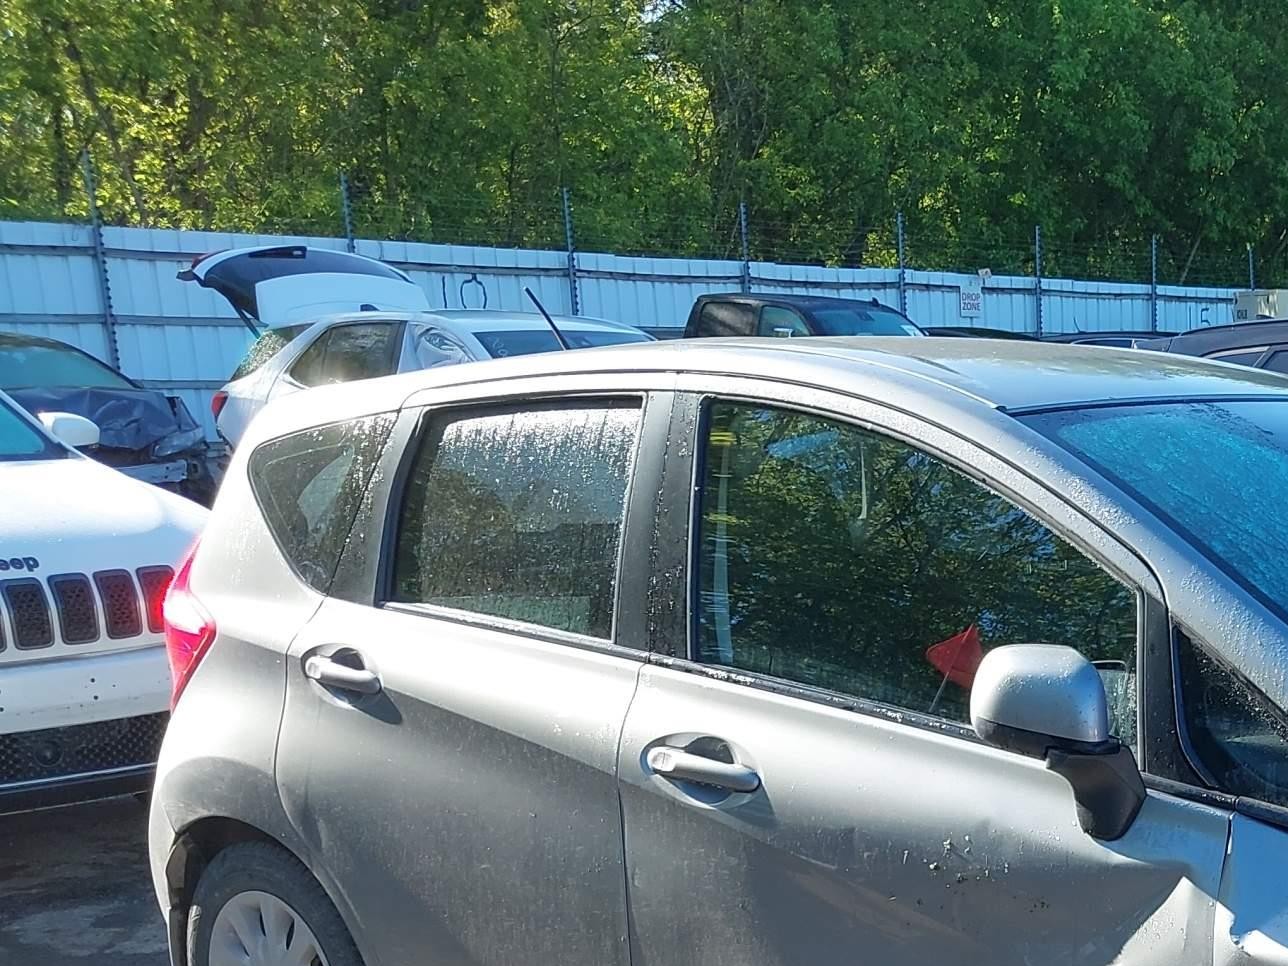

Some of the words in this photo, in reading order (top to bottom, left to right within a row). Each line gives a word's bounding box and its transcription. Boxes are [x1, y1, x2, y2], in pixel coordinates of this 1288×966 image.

[961, 292, 981, 301] DROP
[961, 302, 981, 311] ZONE
[0, 556, 40, 572] eep
